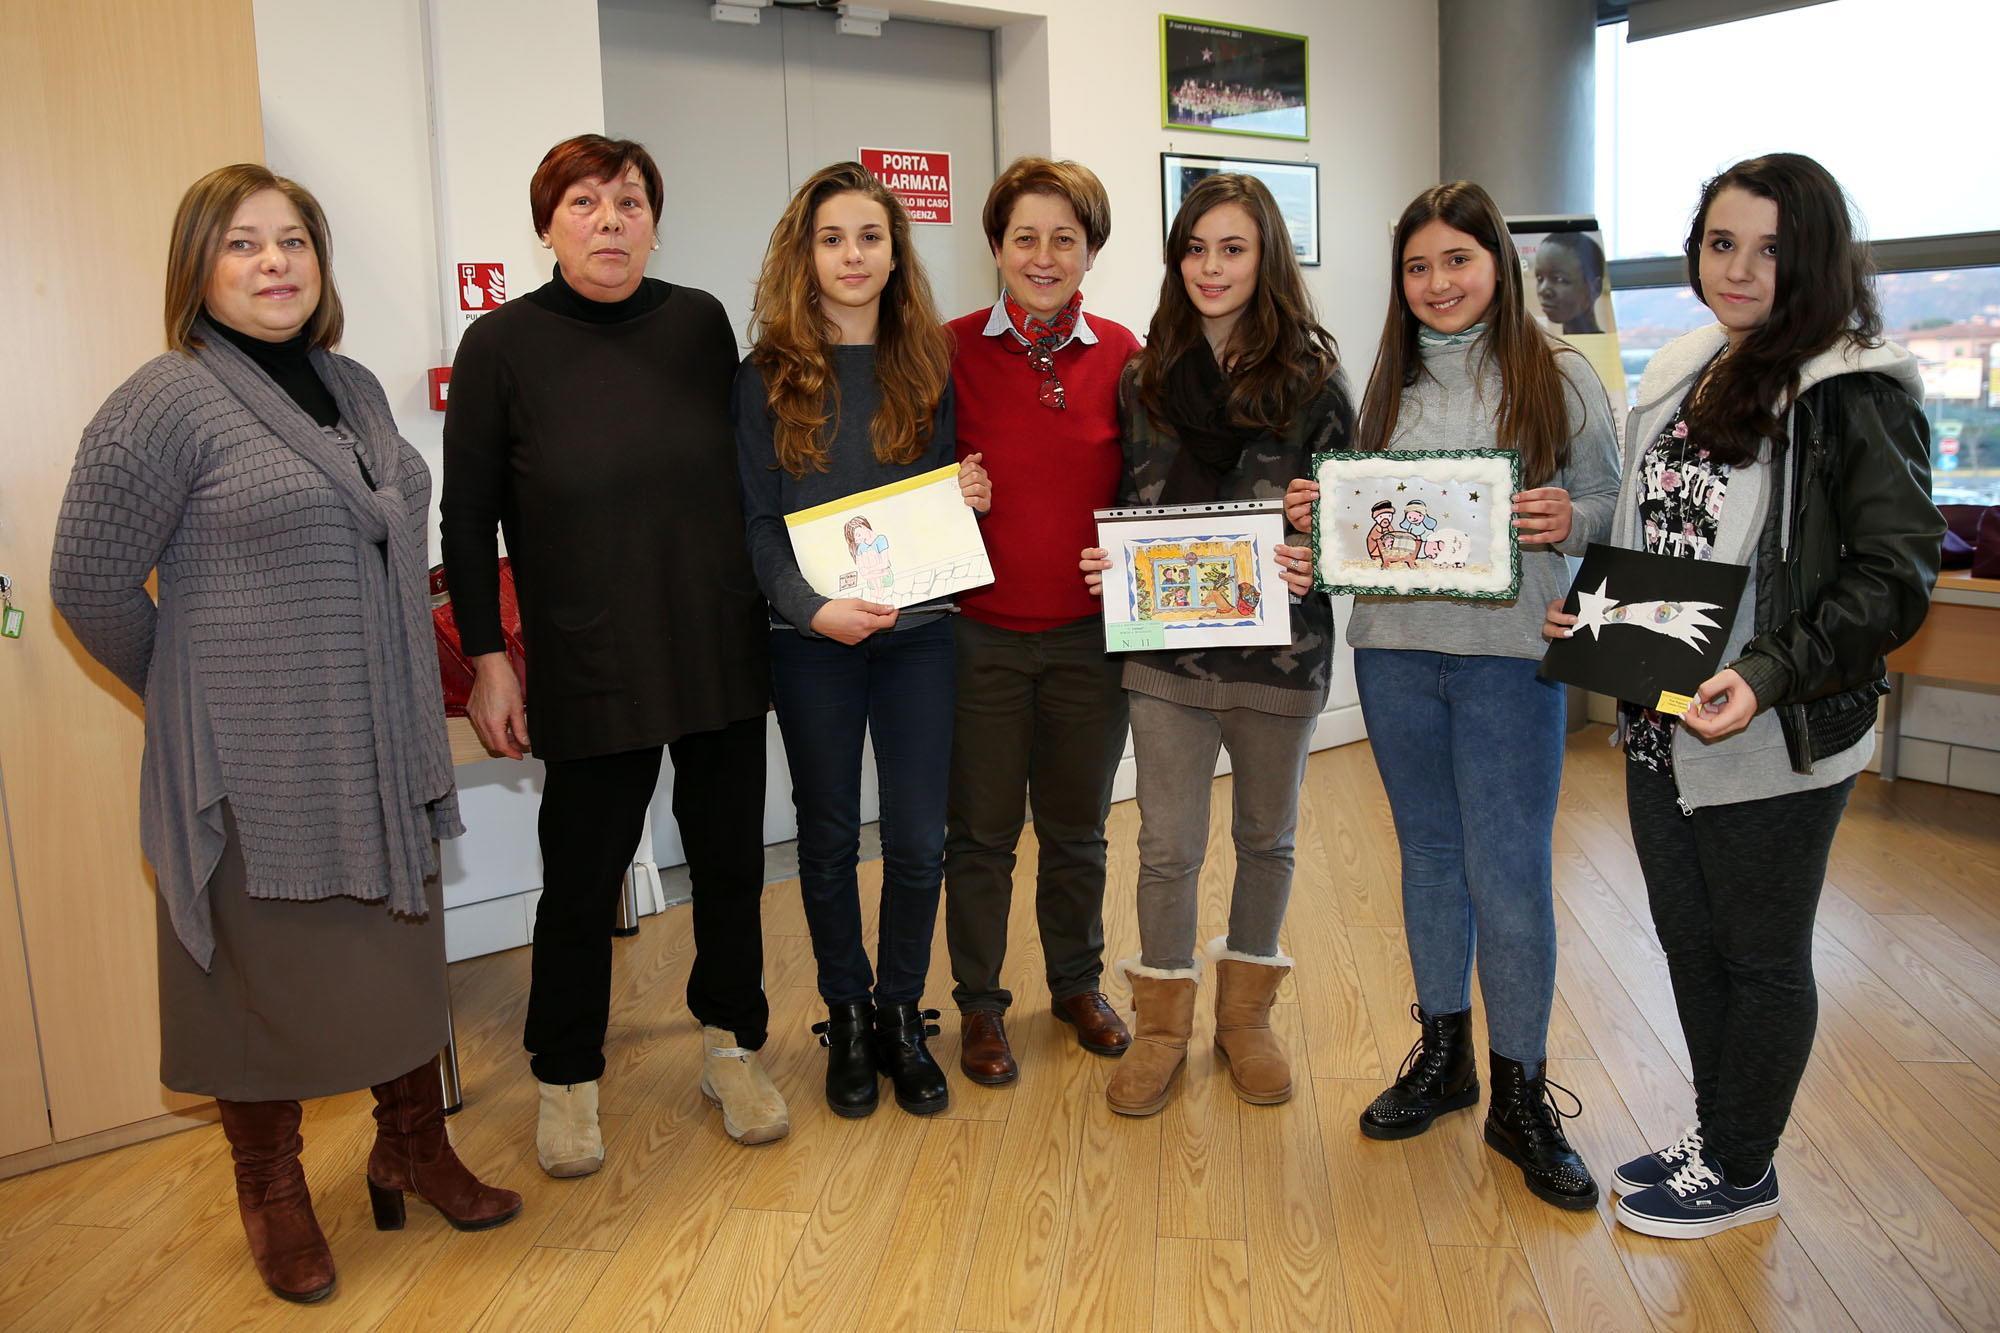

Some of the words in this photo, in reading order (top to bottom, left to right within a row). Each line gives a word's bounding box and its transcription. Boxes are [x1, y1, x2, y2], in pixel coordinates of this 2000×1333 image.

[882, 154, 929, 171] PORTA
[916, 198, 926, 207] IN
[926, 198, 949, 208] CASO
